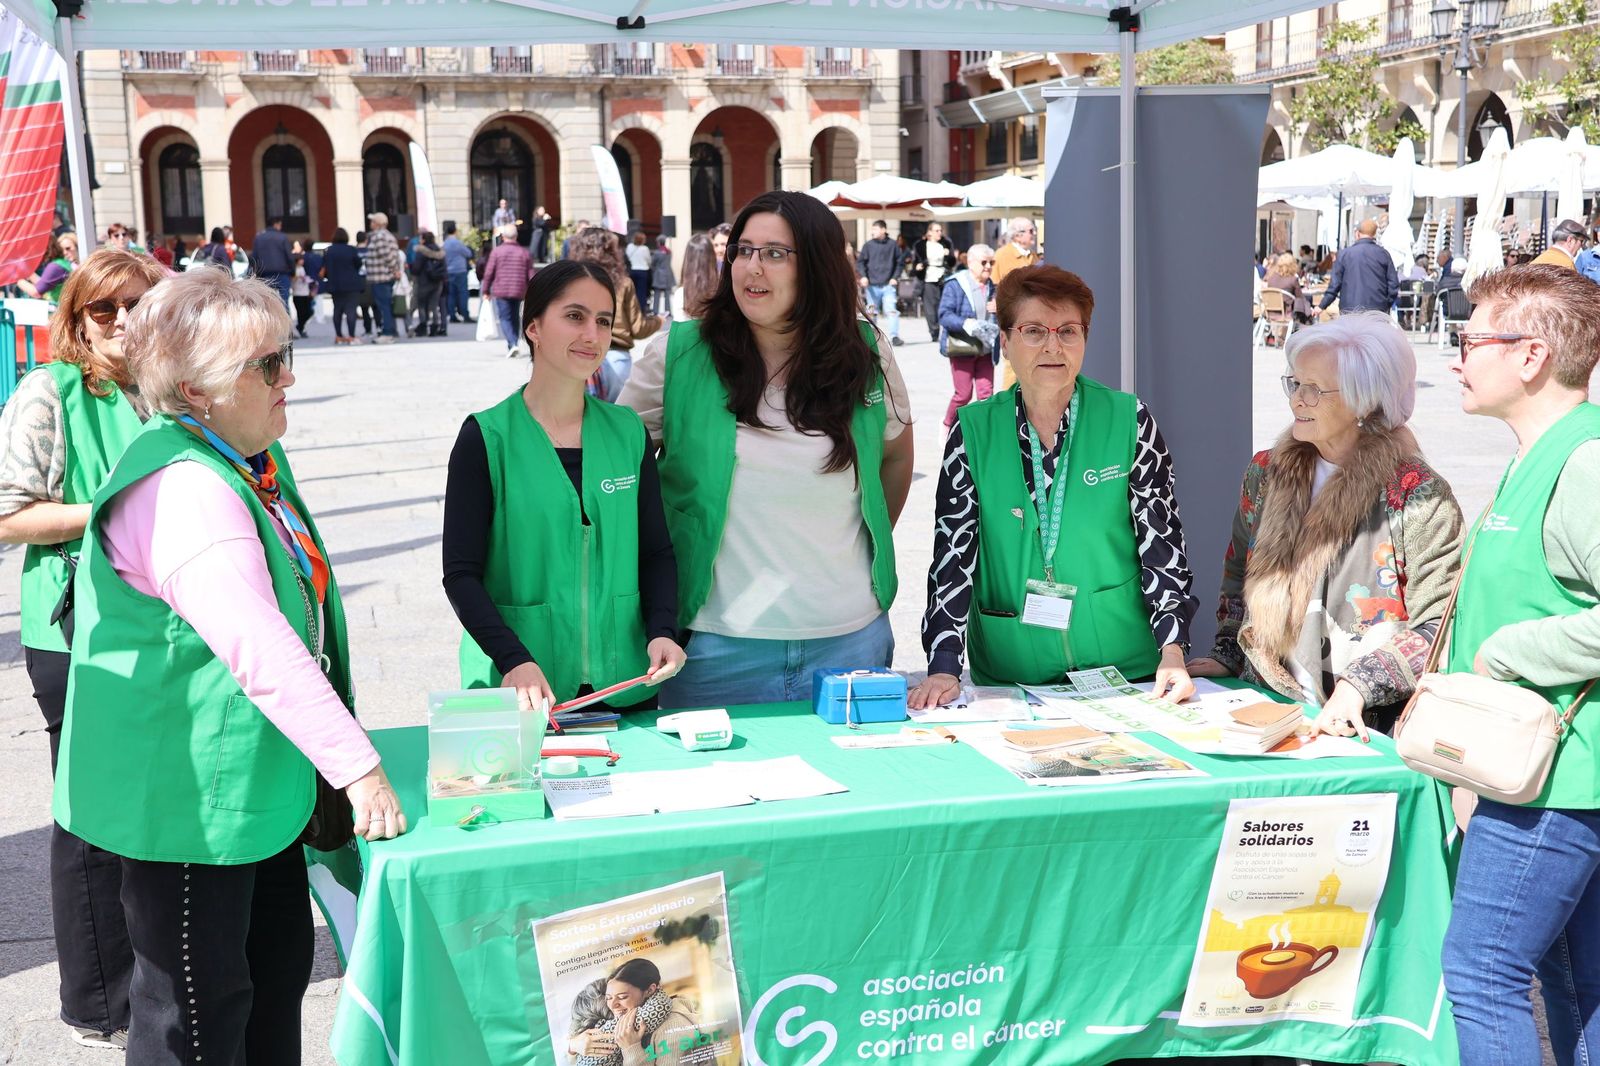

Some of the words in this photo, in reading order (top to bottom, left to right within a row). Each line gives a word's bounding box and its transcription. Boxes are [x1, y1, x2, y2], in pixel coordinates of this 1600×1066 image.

[1239, 834, 1314, 847] solidarios
[1242, 820, 1304, 833] Sabores
[1352, 820, 1370, 832] 21
[550, 922, 595, 940] Sorteo
[600, 895, 696, 928] Extraordinario
[553, 936, 600, 955] Contra
[604, 930, 615, 943] el
[555, 955, 587, 969] Contigo
[587, 943, 624, 959] llegamos
[631, 936, 648, 945] más
[556, 962, 592, 977] personas
[593, 957, 609, 968] que
[610, 952, 625, 960] nos
[625, 939, 663, 956] necesitan
[862, 961, 1004, 997] asociación
[859, 994, 981, 1031] española
[857, 1029, 944, 1059] contra
[951, 1024, 975, 1053] el
[983, 1016, 1066, 1048] cáncer
